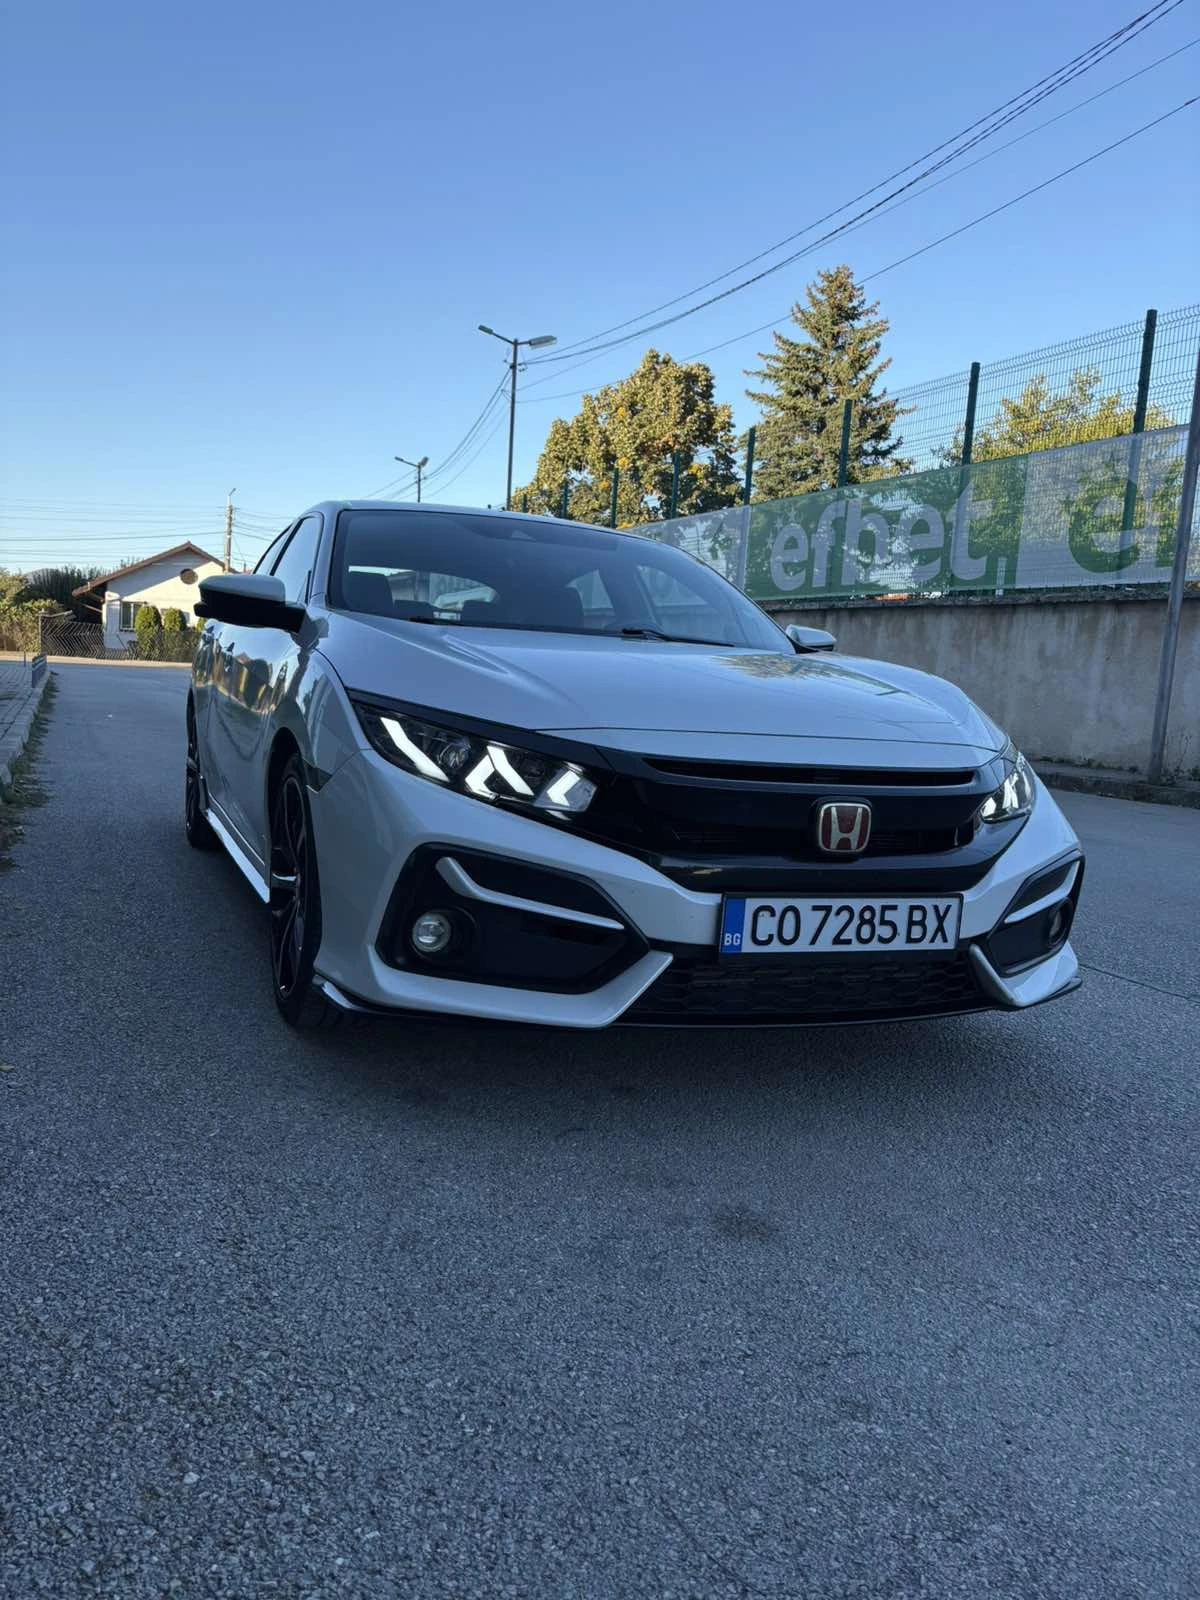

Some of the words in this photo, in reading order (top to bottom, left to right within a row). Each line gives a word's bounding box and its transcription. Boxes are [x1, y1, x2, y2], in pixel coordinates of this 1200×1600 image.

[770, 483, 994, 592] efbet
[723, 933, 742, 946] BG
[808, 904, 899, 946] 7285
[905, 903, 953, 944] BX
